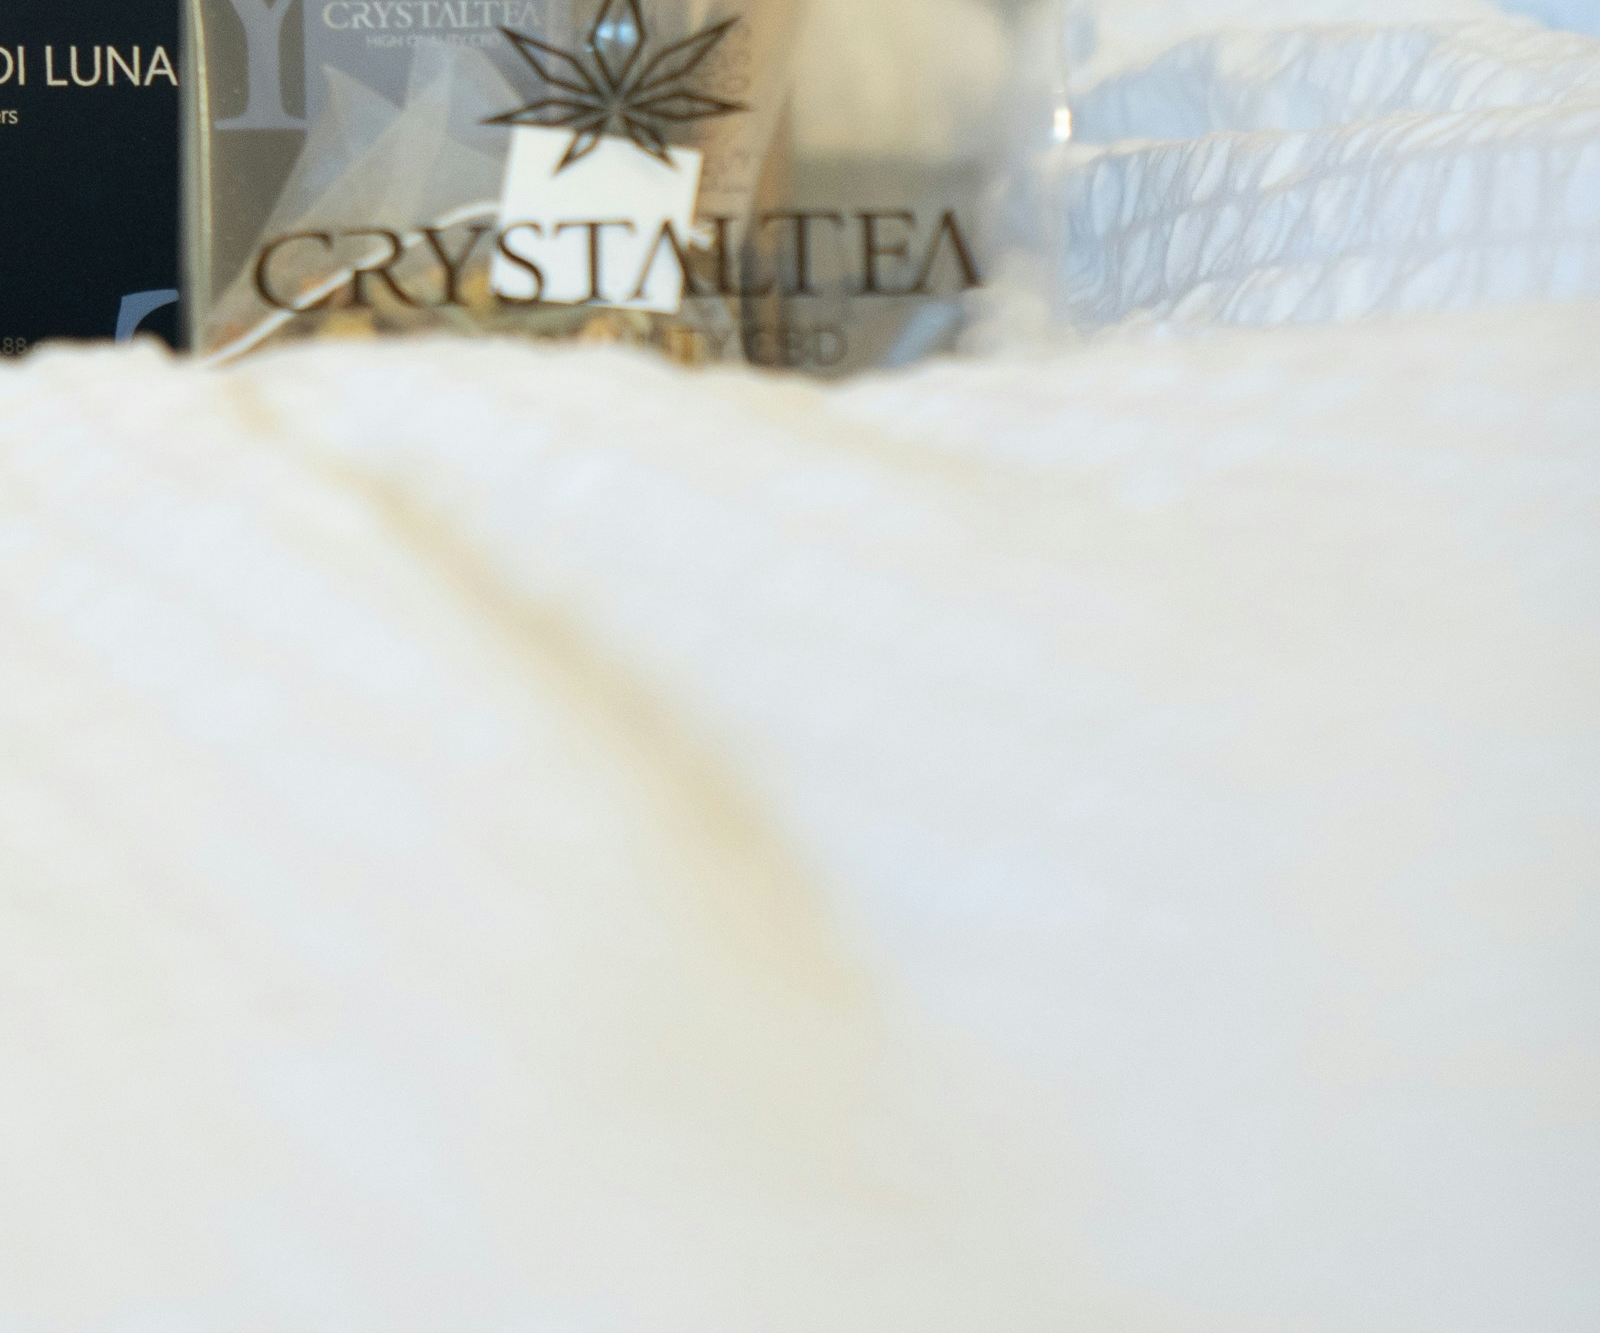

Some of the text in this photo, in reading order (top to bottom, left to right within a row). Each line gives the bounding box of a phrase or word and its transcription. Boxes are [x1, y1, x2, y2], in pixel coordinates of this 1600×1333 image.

[321, 0, 541, 30] CRYSTALTEA
[45, 45, 180, 88] LUNA
[251, 207, 986, 313] CRYSTALTEA
